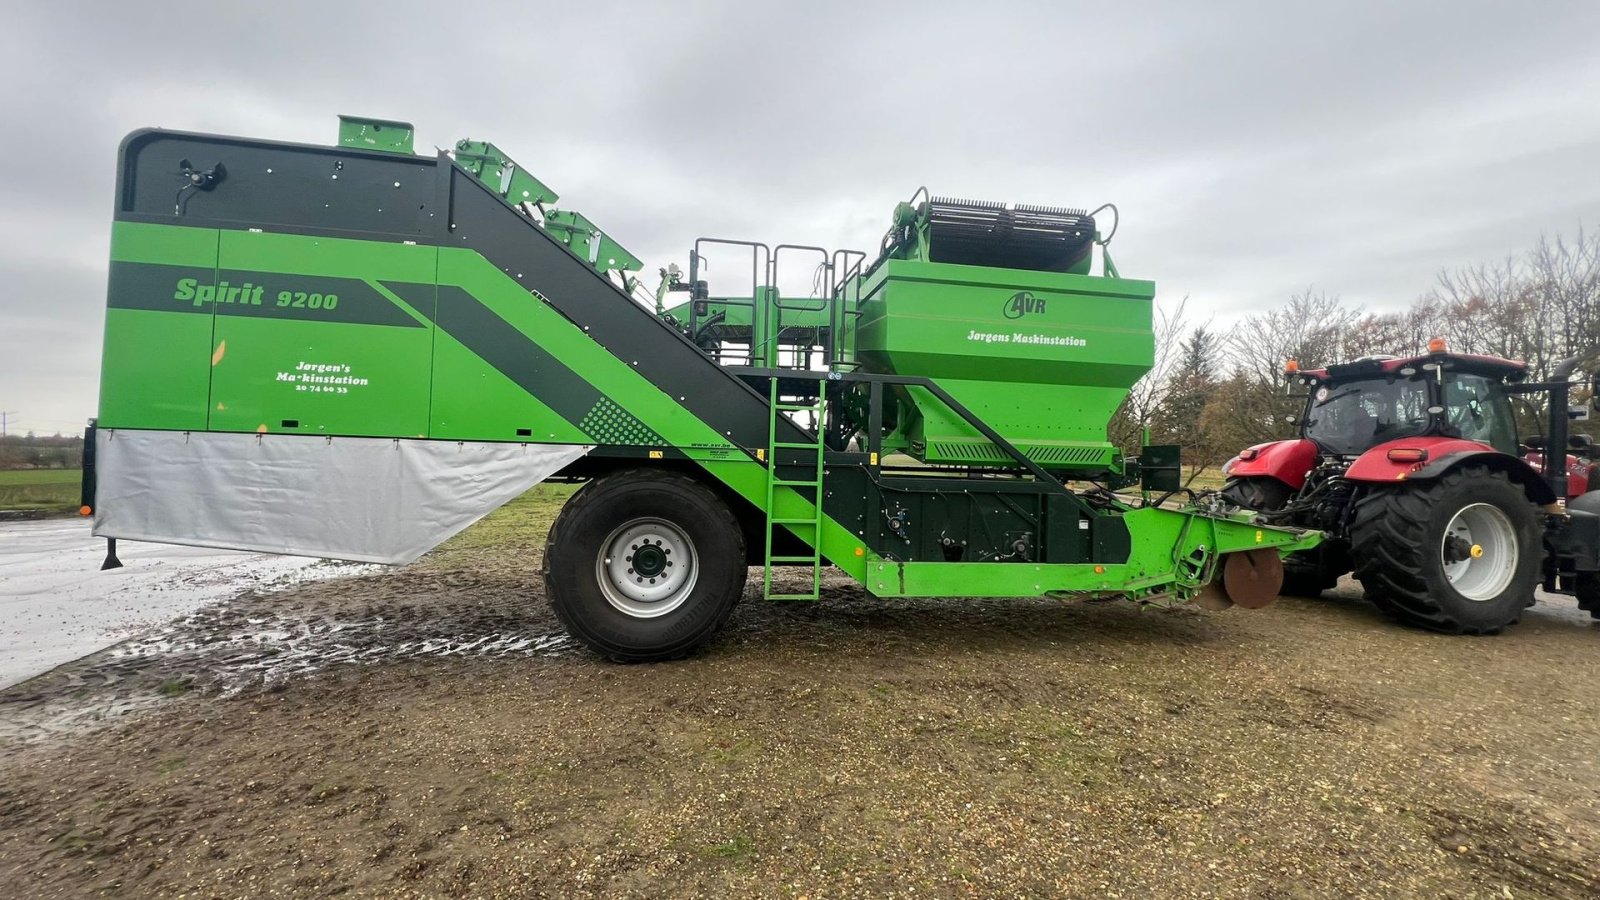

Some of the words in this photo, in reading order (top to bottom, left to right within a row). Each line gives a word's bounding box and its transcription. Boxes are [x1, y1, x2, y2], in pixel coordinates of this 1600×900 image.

[174, 278, 264, 306] Spirit
[276, 291, 338, 310] 9200
[1008, 292, 1046, 318] AVR
[967, 330, 1010, 343] Jørgens
[1012, 333, 1087, 347] Maskinstation
[296, 361, 351, 373] Jørgen's
